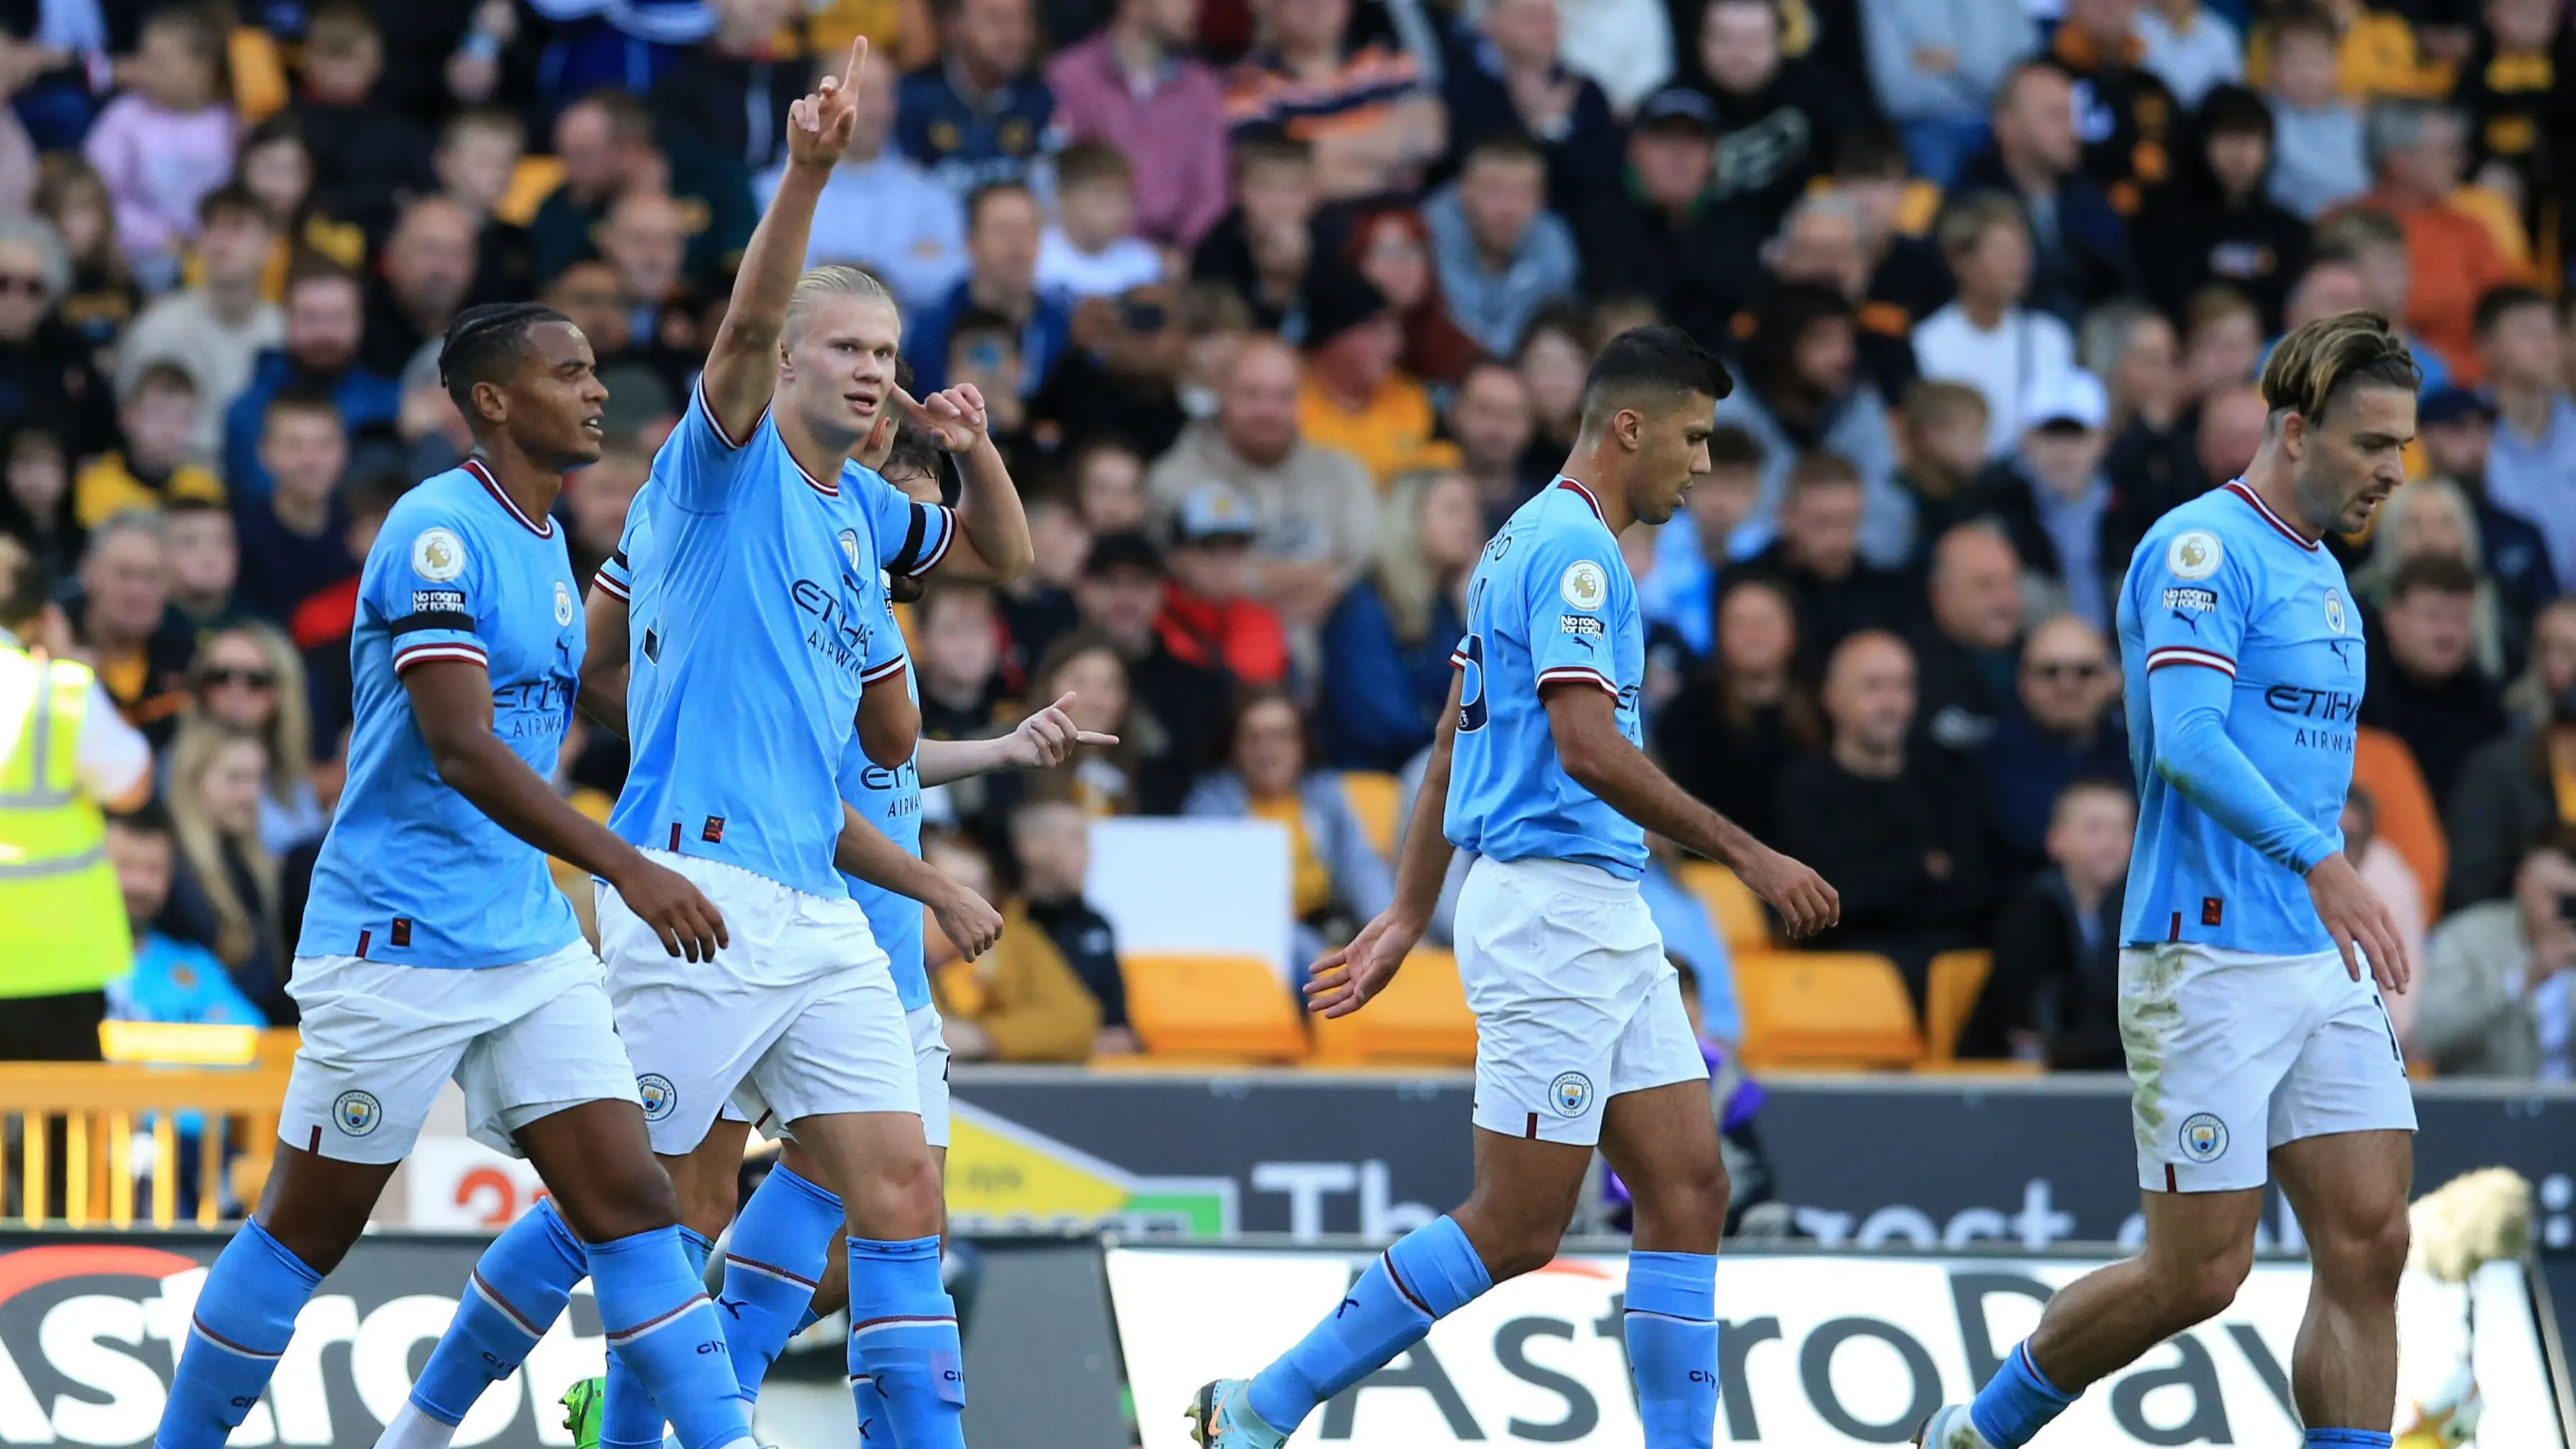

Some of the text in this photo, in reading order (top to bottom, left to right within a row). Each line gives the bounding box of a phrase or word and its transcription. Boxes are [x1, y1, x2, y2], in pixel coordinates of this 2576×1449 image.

[413, 591, 461, 603] No room
[1561, 616, 1578, 626] No
[1688, 1370, 1717, 1390] CIT
